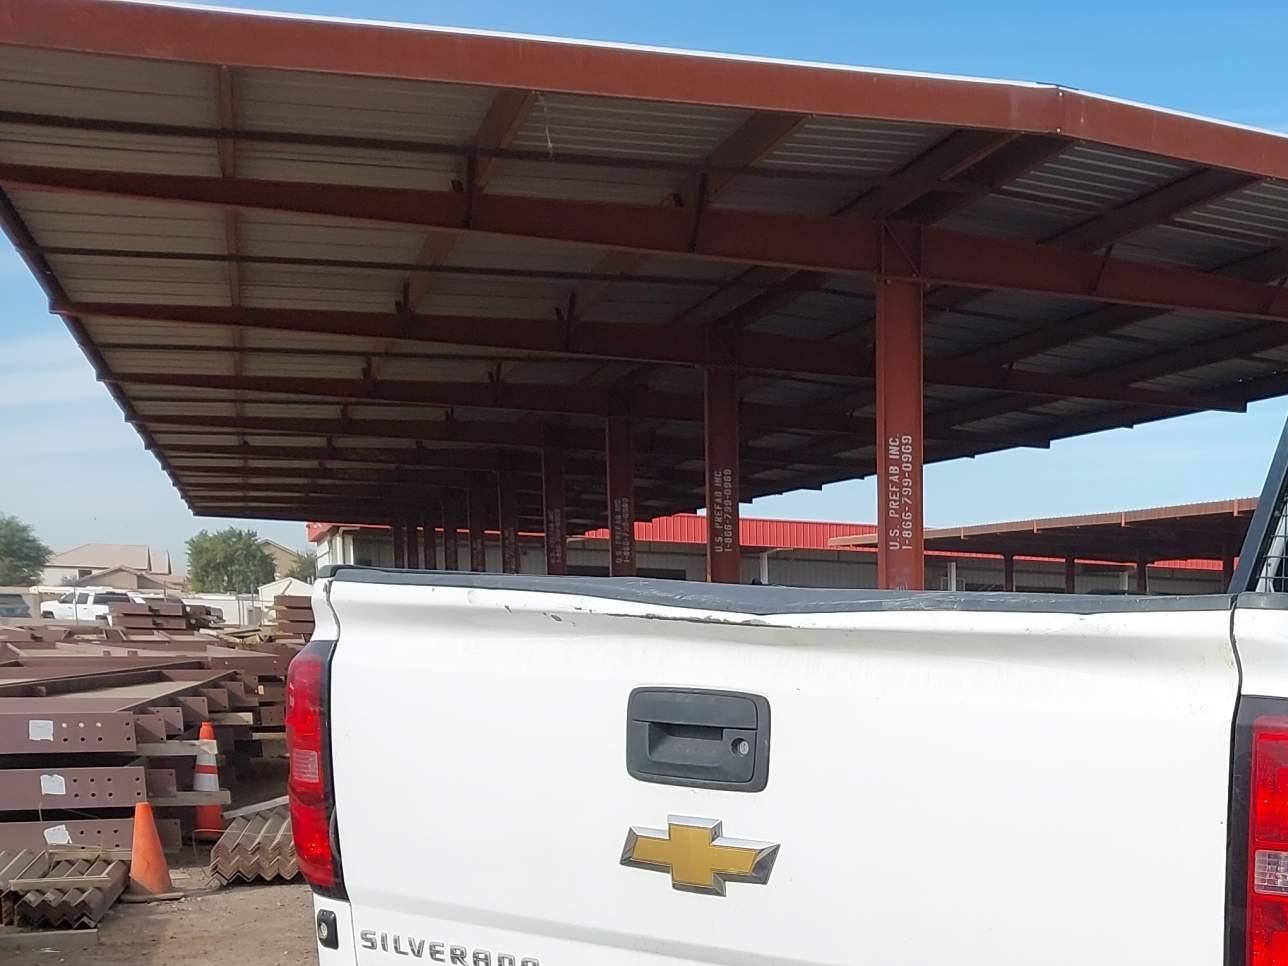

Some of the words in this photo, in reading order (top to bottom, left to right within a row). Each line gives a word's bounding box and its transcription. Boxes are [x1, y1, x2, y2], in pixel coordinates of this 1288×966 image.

[888, 434, 900, 459] INC.
[889, 465, 900, 518] PREFAB
[901, 435, 913, 550] 1-866-799-0969
[889, 525, 900, 550] U.S.
